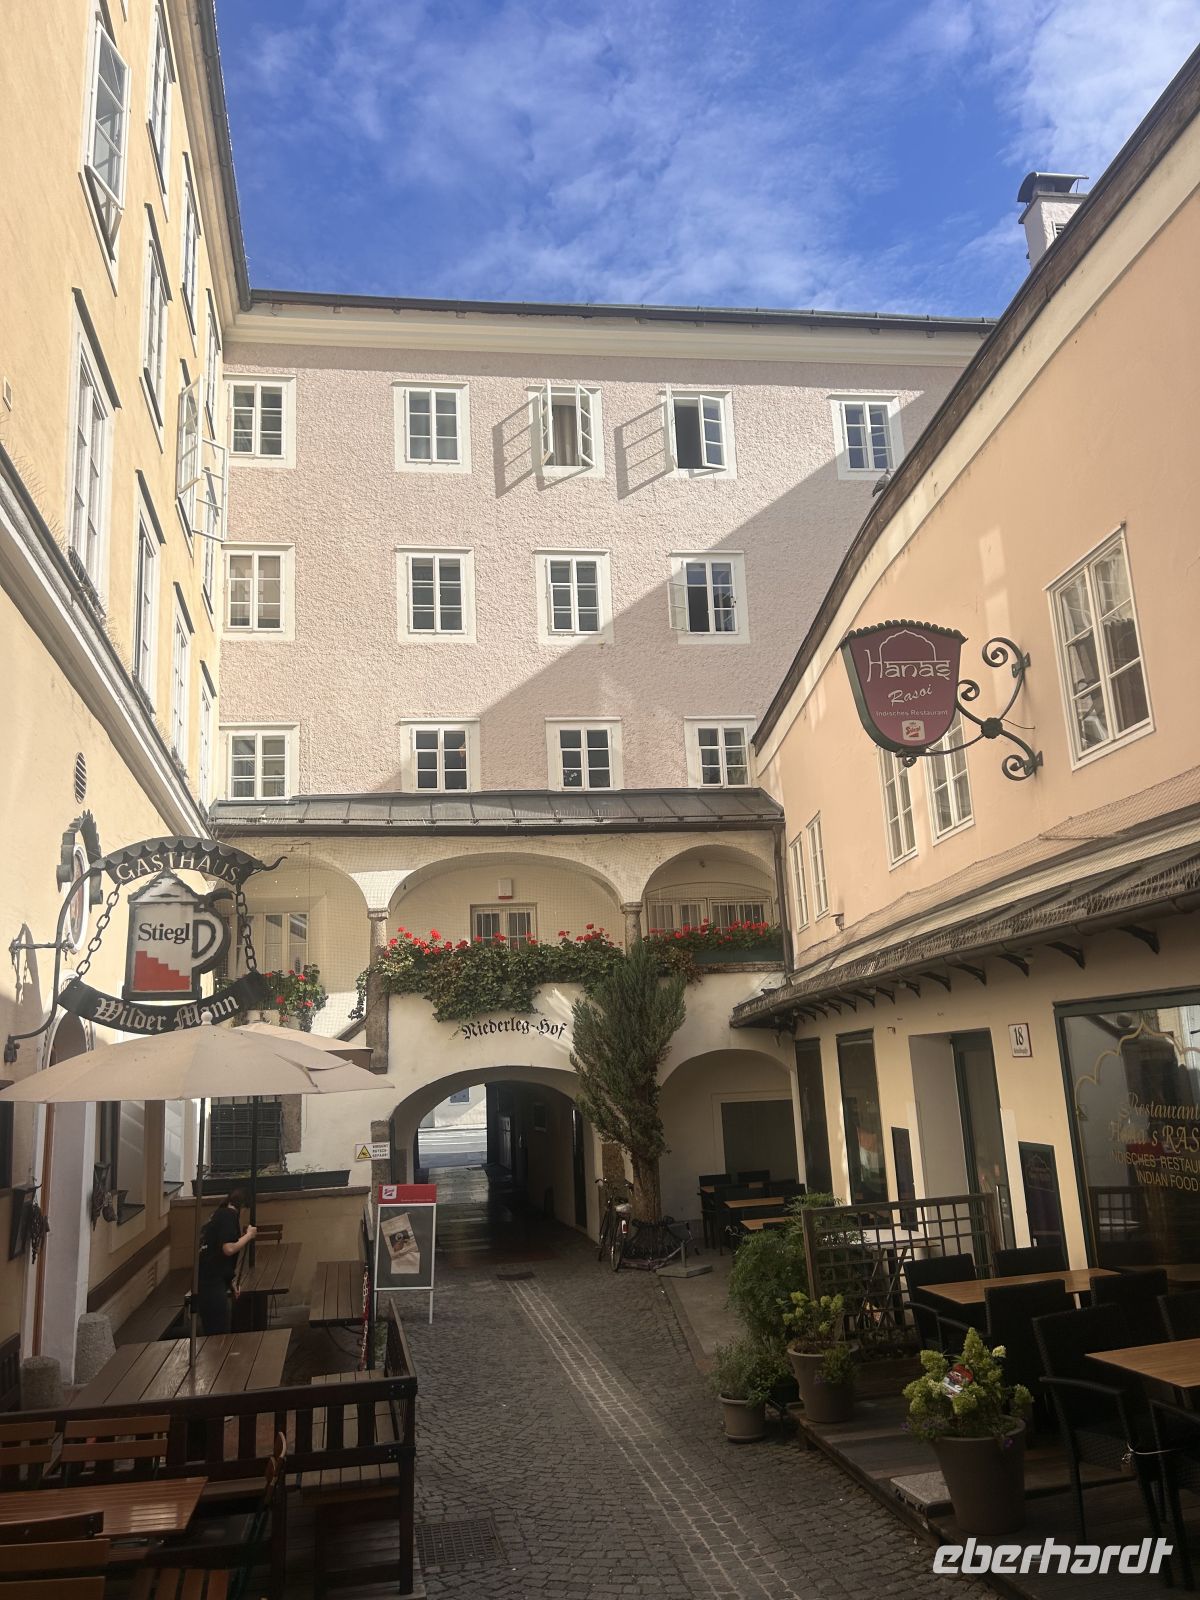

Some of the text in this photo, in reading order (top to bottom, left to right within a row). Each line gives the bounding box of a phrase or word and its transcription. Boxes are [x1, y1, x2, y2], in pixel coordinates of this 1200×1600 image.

[864, 649, 951, 682] Hanas
[888, 683, 932, 707] Rasoi
[876, 708, 948, 717] Indisches Restaurant
[115, 851, 241, 881] GASTHAUS
[137, 922, 190, 944] Stiegl
[94, 997, 167, 1031] Wilder
[461, 1016, 568, 1040] Niederleg-Hof
[1014, 1026, 1024, 1046] 18
[1136, 1169, 1199, 1192] INDIAN FOOD
